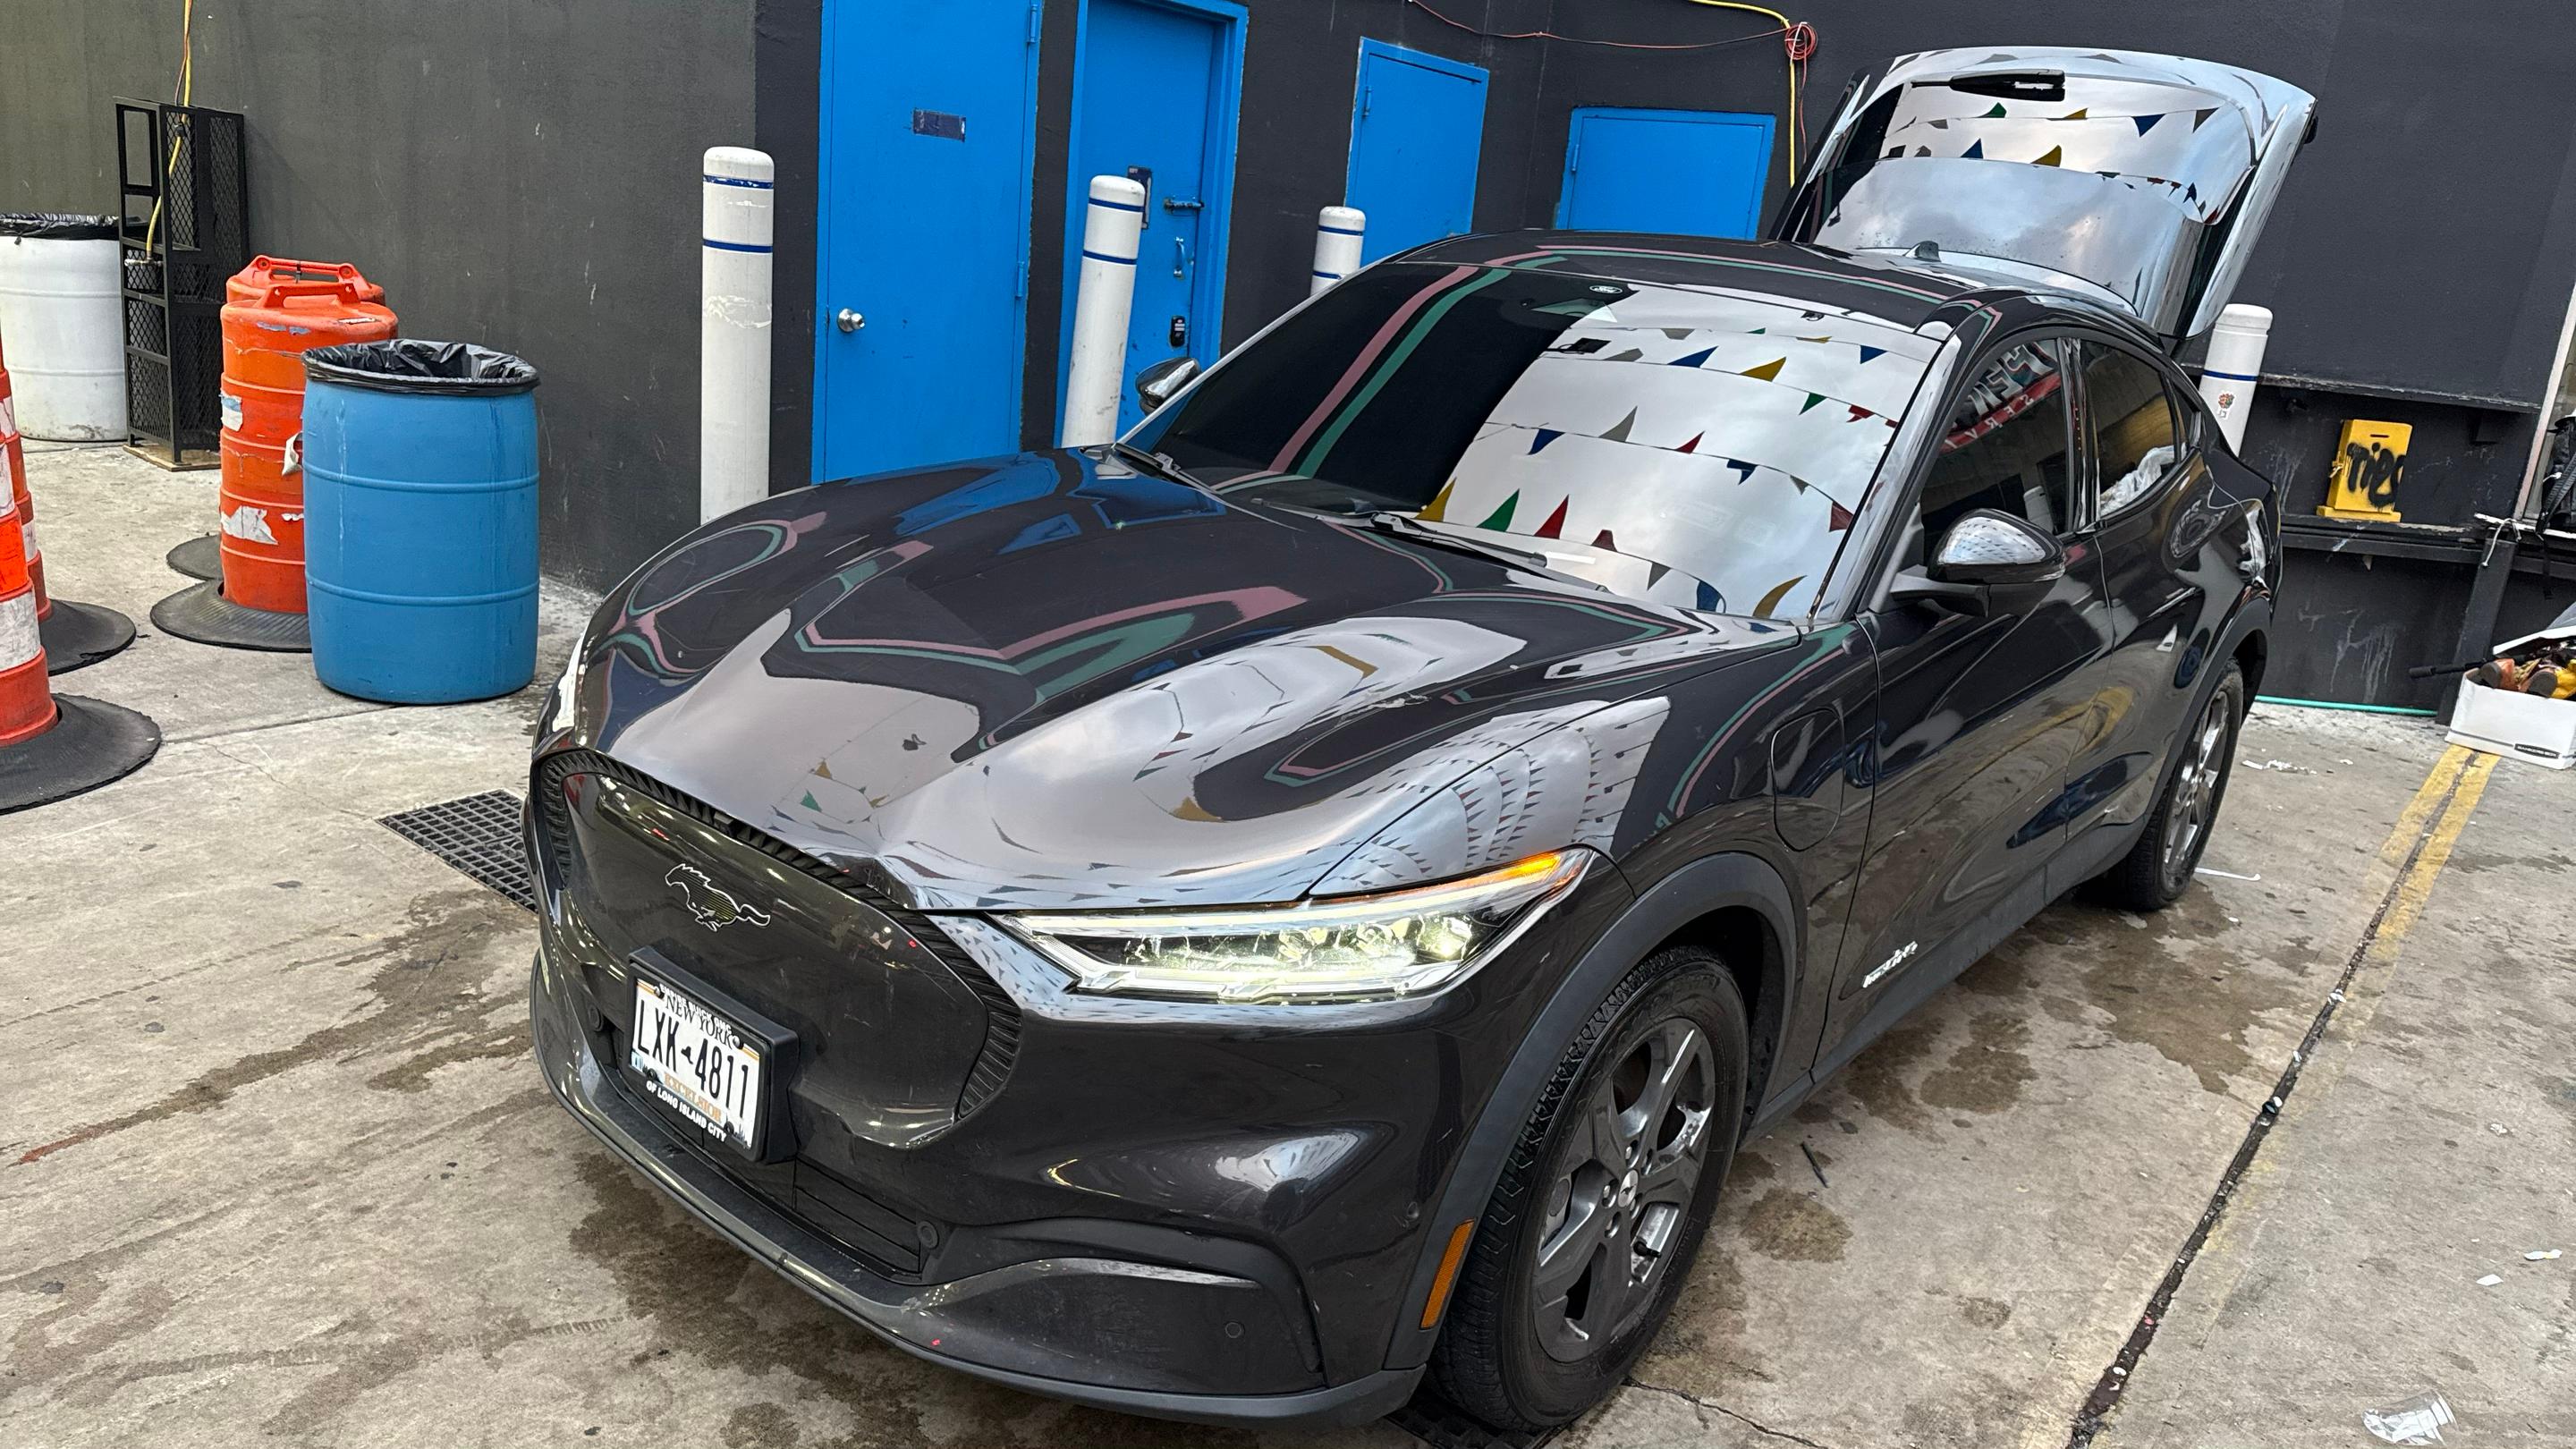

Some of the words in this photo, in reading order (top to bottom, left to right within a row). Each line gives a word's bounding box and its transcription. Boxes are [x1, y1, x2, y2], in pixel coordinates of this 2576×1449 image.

[665, 995, 696, 1024] NEW
[699, 1016, 733, 1050] YORK
[638, 999, 680, 1073] LXK
[695, 1038, 749, 1119] 4811
[646, 1080, 657, 1094] OF
[657, 1087, 679, 1109] LONG
[679, 1100, 708, 1129] ISLAND
[708, 1122, 727, 1142] CITY
[664, 1072, 722, 1123] EXCELSIOR
